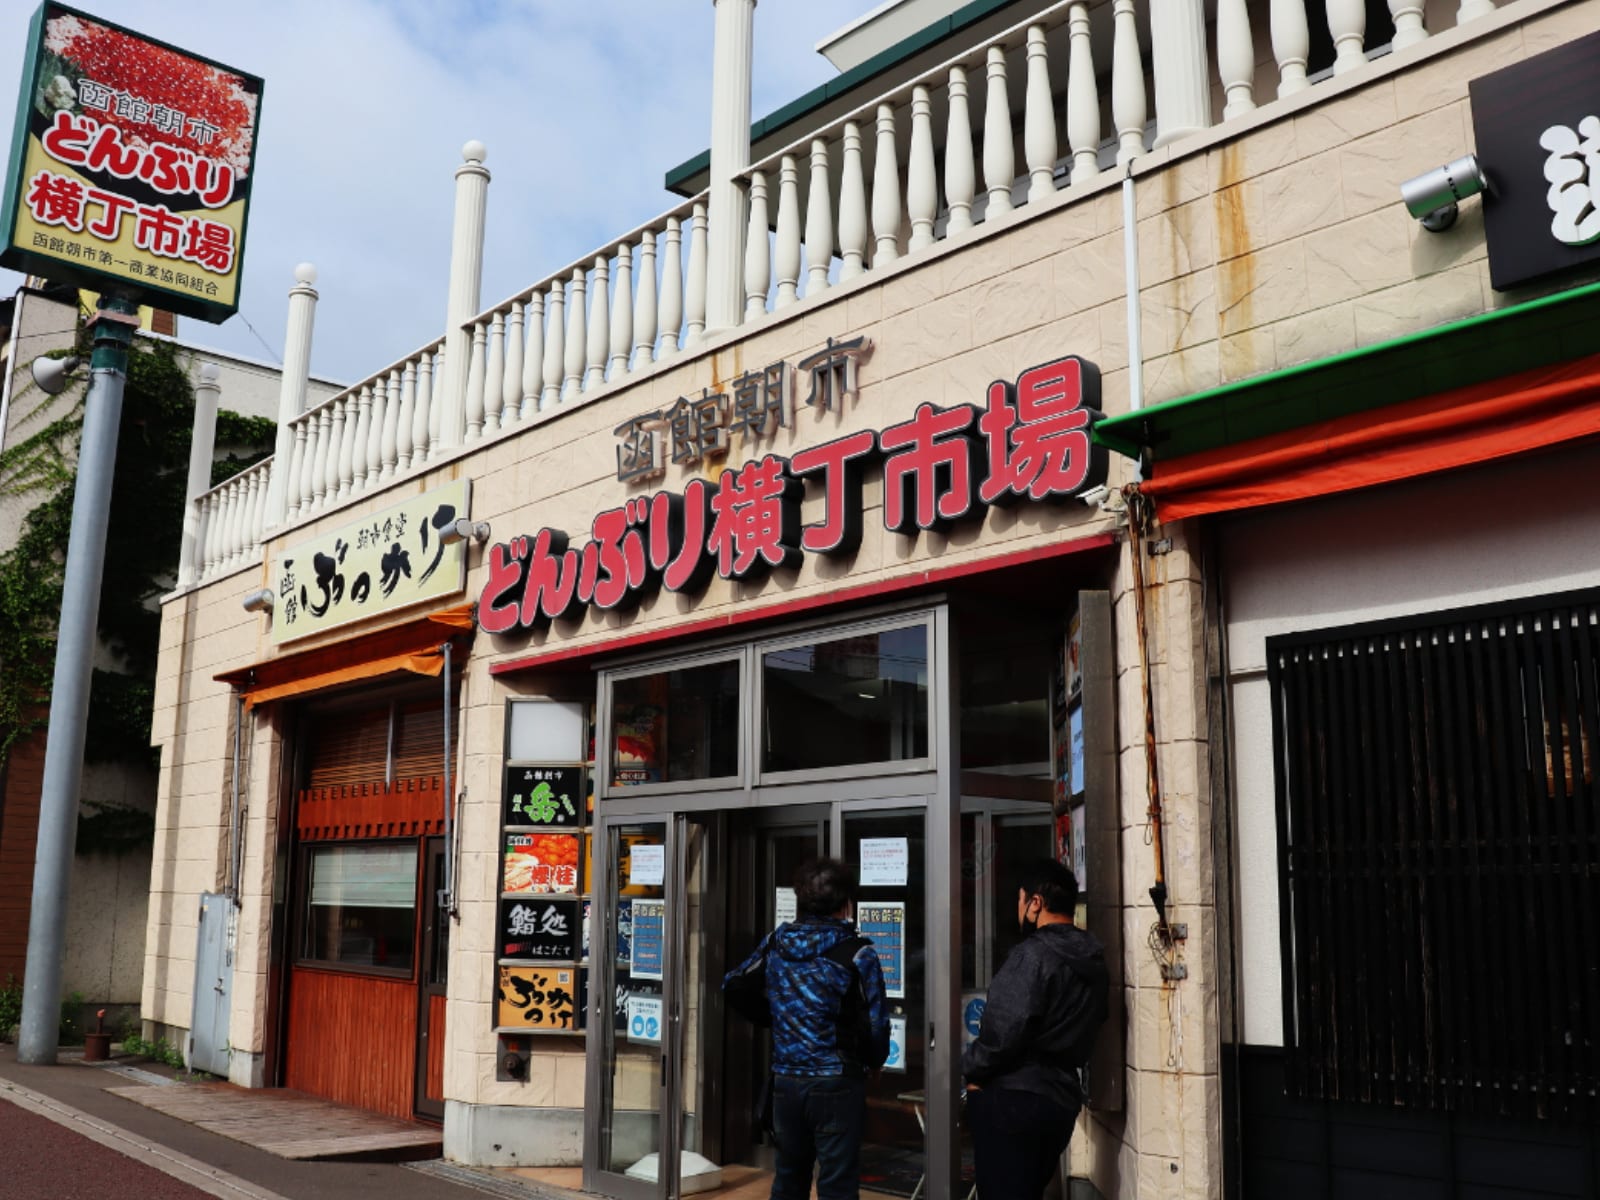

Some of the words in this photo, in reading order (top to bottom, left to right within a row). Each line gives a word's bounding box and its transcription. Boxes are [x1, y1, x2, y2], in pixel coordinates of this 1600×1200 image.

[79, 80, 219, 145] 函館朝市
[46, 113, 231, 204] どんぶり
[29, 173, 231, 270] 横丁市場
[32, 231, 219, 297] 函館朝市第一商業協同組合
[614, 335, 873, 483] 函館朝市
[478, 355, 1097, 634] どんぶり横丁市場
[507, 903, 569, 936] 鮨処
[532, 943, 572, 956] はこだて
